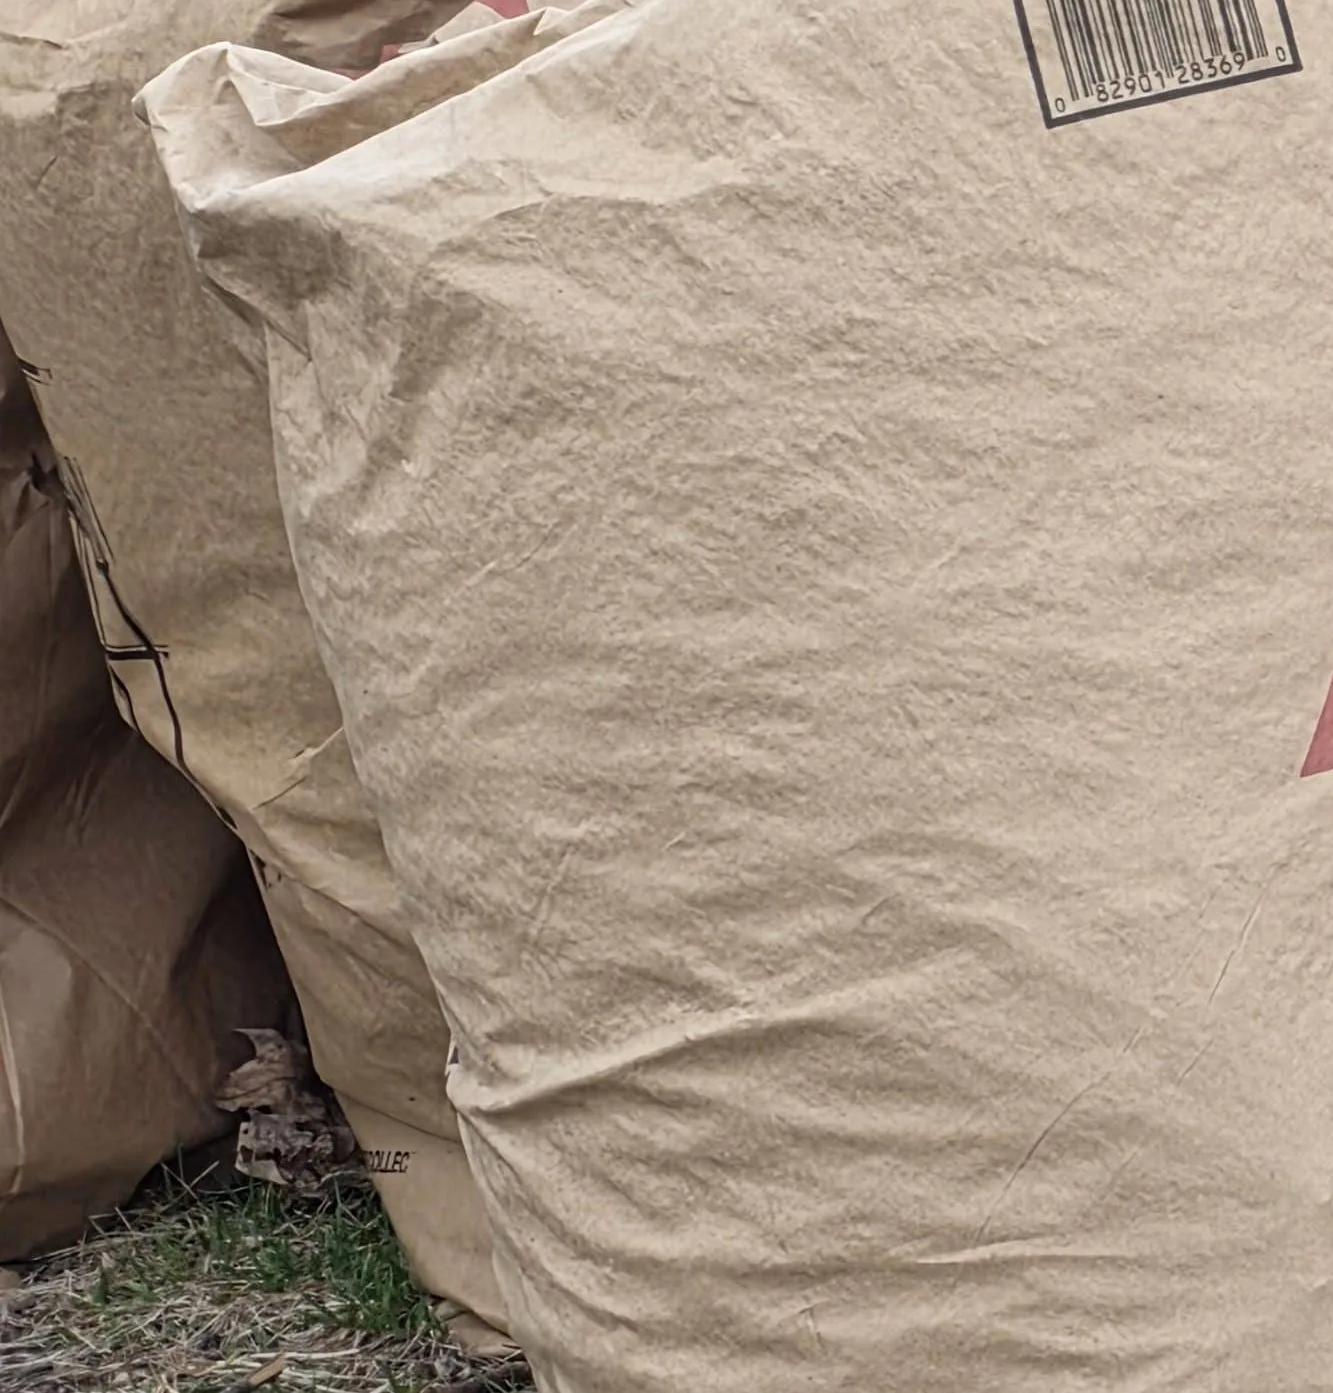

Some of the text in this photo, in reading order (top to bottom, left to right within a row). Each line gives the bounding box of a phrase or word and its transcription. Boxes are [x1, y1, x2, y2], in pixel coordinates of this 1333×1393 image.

[1054, 45, 1288, 113] 0 82901 28369 0
